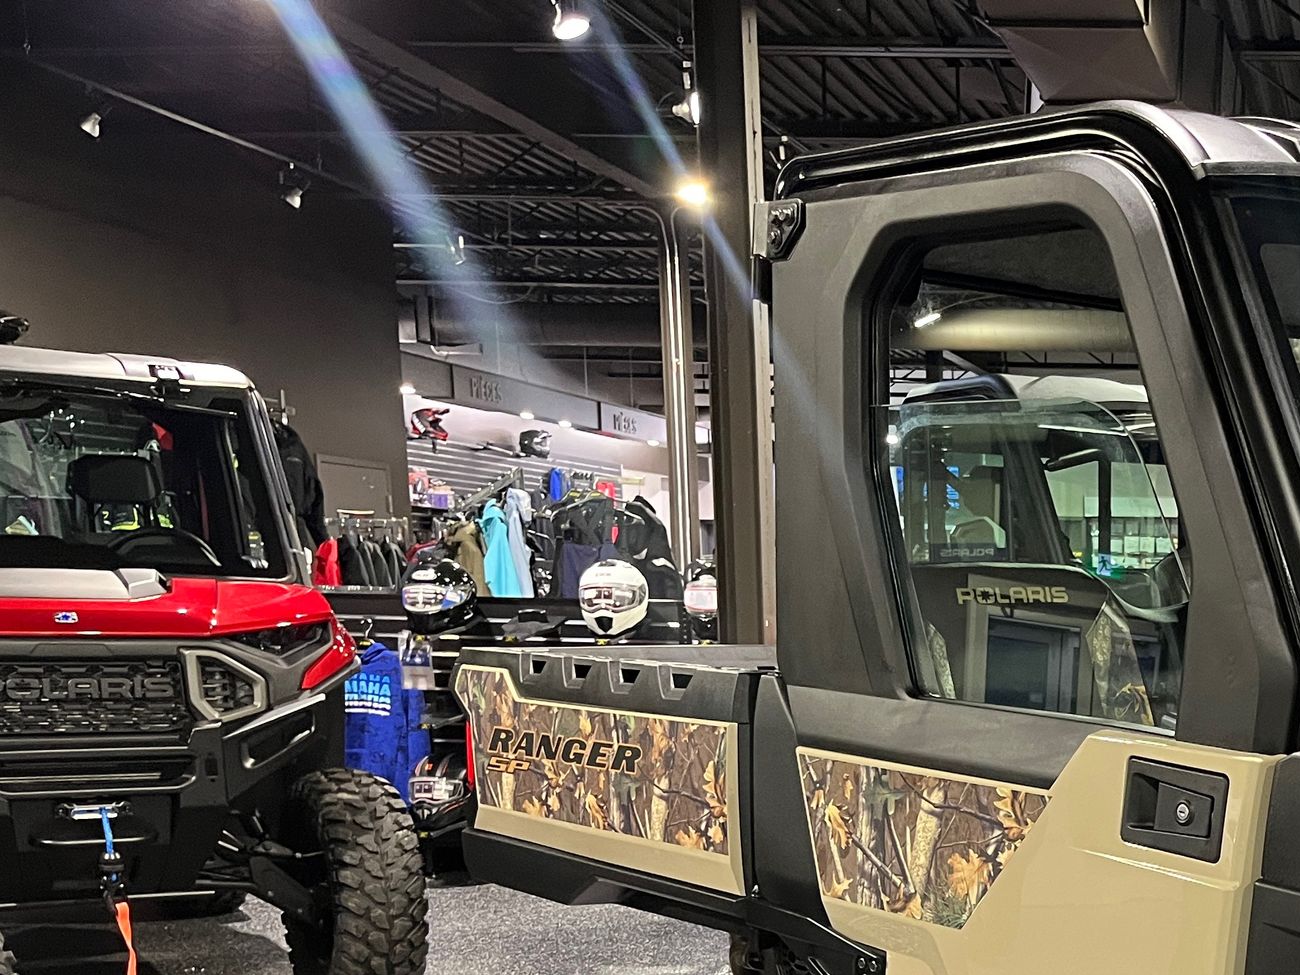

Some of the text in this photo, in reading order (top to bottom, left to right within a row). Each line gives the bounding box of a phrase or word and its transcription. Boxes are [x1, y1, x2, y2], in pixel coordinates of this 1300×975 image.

[956, 586, 1069, 606] POLARIS
[487, 726, 643, 775] RANGER
[487, 756, 531, 774] SP
